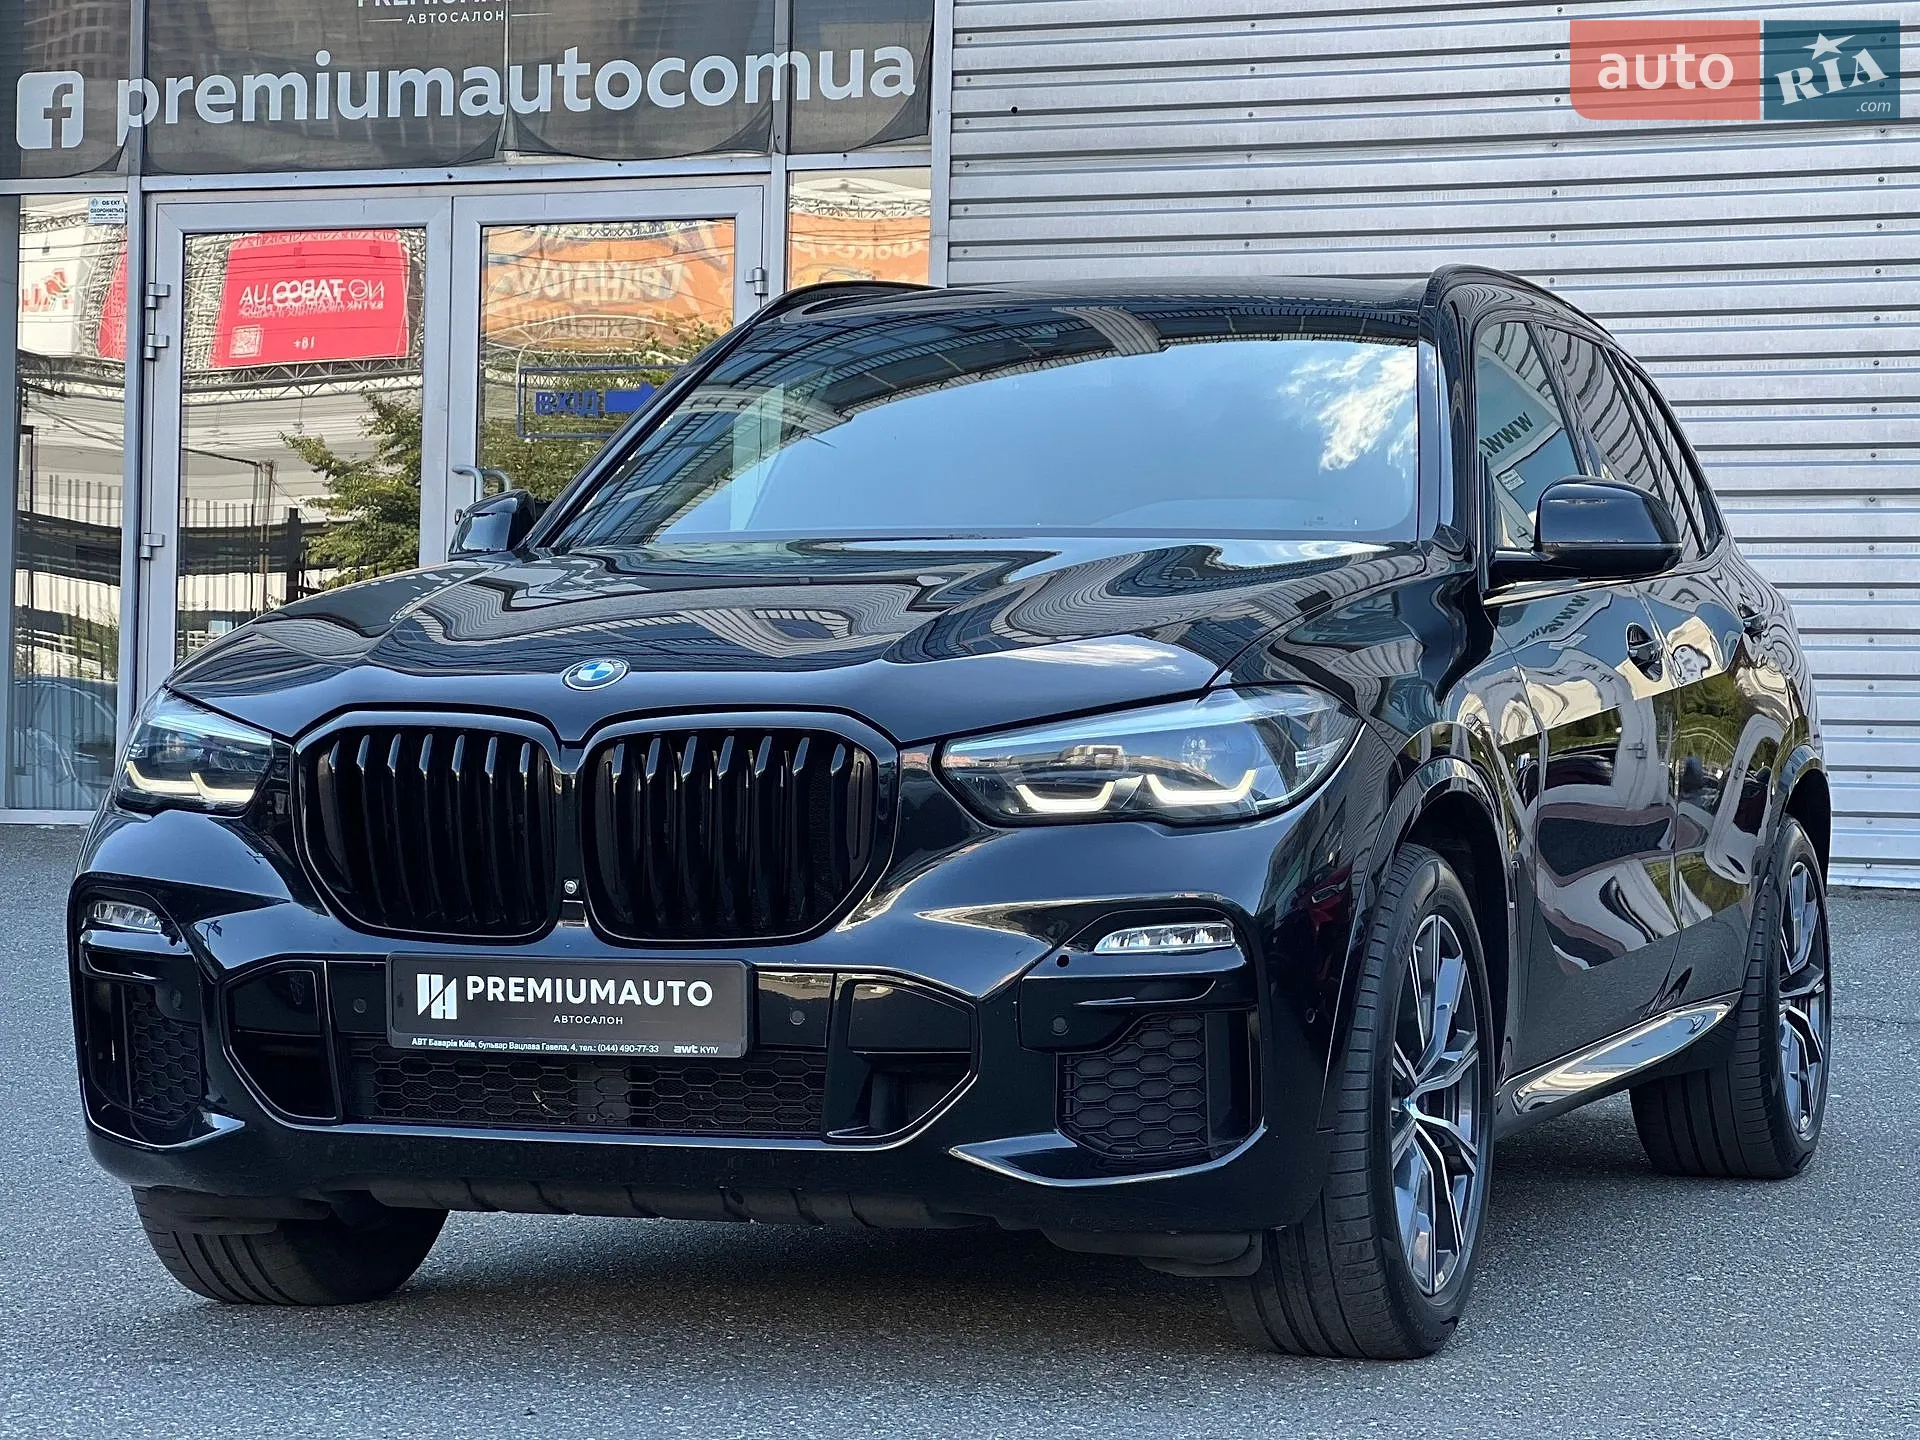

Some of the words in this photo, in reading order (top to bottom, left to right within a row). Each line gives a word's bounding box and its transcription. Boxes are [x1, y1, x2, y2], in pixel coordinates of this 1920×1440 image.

[407, 10, 504, 25] АВТОСАЛОН
[117, 45, 916, 147] premiumautocomua
[466, 975, 713, 1007] PREMIUMAUTO
[553, 1015, 623, 1025] АВТОСАЛОН
[411, 1038, 427, 1046] АВТ
[479, 1040, 507, 1050] бульвар
[509, 1041, 540, 1050] Вацлава
[597, 1044, 618, 1053] (044)
[620, 1044, 659, 1053] 490-77-33
[674, 1045, 699, 1054] awt
[700, 1046, 719, 1054] KYIV
